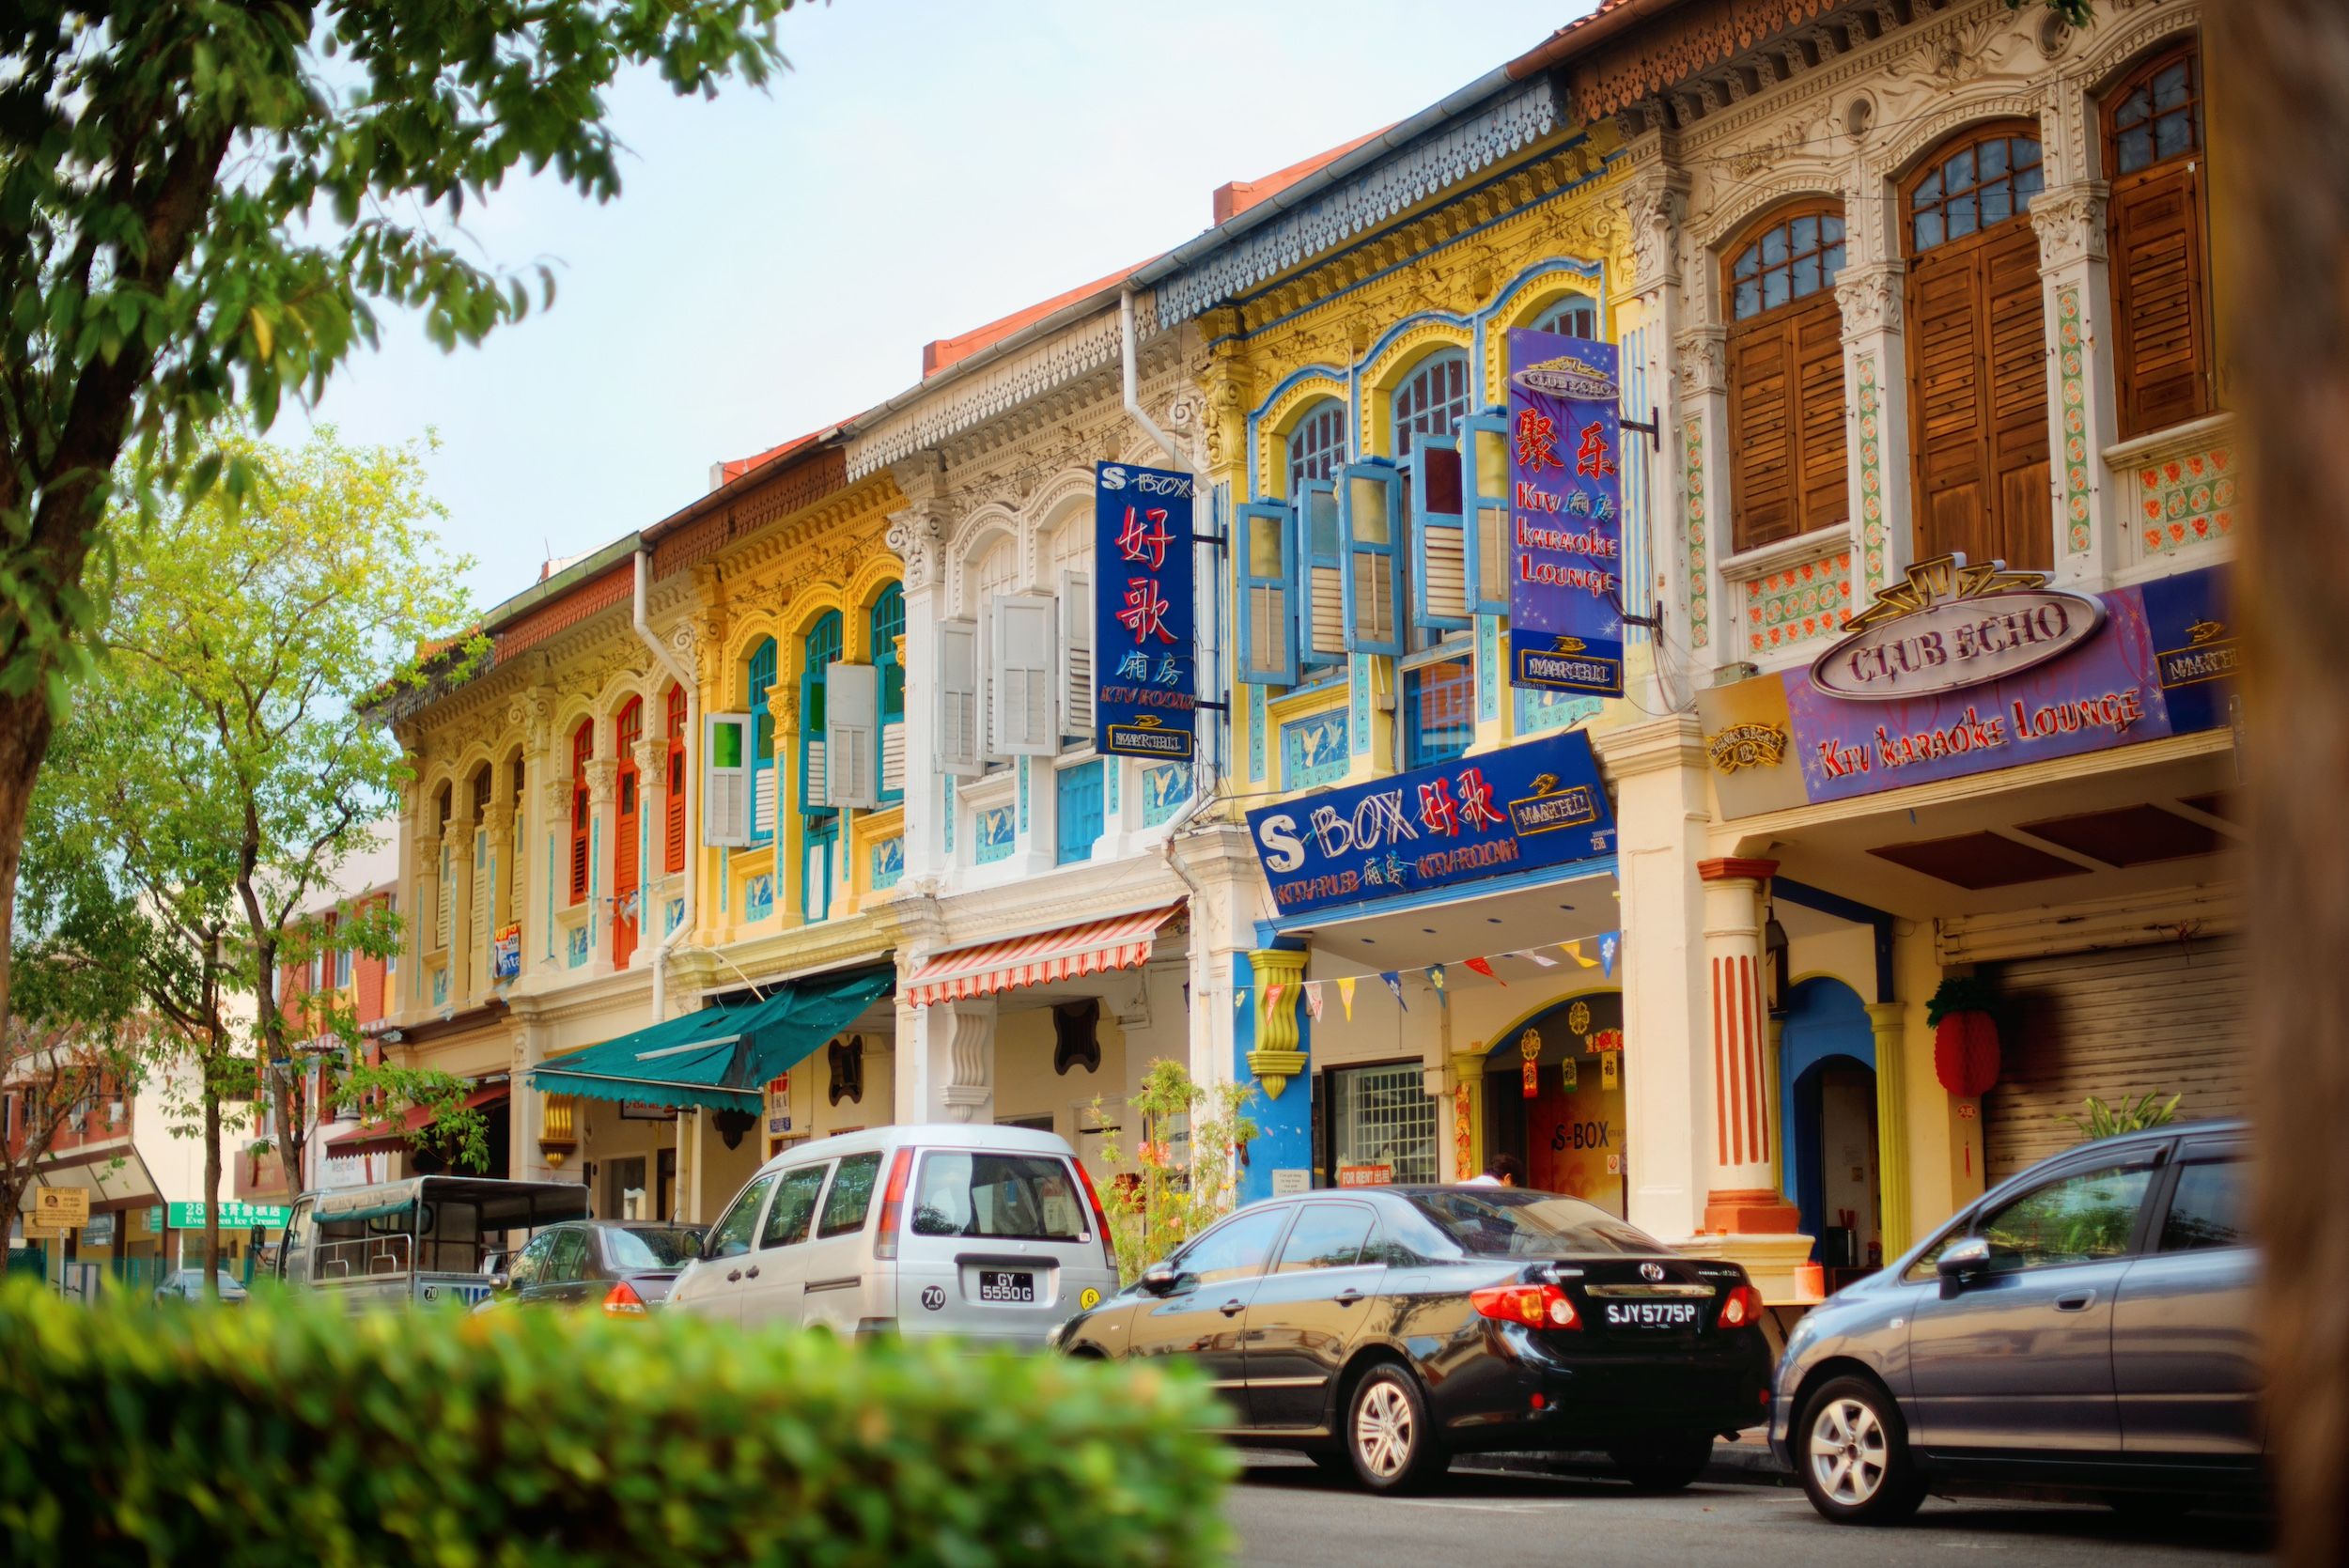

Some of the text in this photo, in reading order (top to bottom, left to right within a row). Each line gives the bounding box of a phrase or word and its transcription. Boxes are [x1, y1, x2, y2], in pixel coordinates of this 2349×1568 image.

[1525, 372, 1610, 396] CLUB ECHO
[1516, 408, 1615, 480] 聚乐
[1517, 517, 1618, 558] KARAOKE
[1114, 505, 1178, 644] 好歌
[1521, 553, 1615, 598] LOUNGE
[1847, 601, 2070, 684] CLUB ECHO
[1528, 659, 1610, 682] MARTELL
[1100, 685, 1195, 710] KTV ROOM
[1115, 732, 1181, 752] MARTELL
[1820, 689, 2146, 780] KTV KARAOKE LOUNGE
[1417, 767, 1508, 838] 好歌
[1517, 793, 1592, 826] MARTELL
[1552, 1121, 1609, 1151] S-BOX
[1343, 1170, 1373, 1185] FOR RENT
[1374, 1169, 1390, 1183] 出租
[185, 1203, 205, 1216] 28
[234, 1218, 247, 1226] Ice
[250, 1216, 281, 1225] Cream
[997, 1273, 1015, 1286] GY
[427, 1288, 438, 1298] 70
[925, 1289, 943, 1304] 70
[1087, 1293, 1094, 1303] 6
